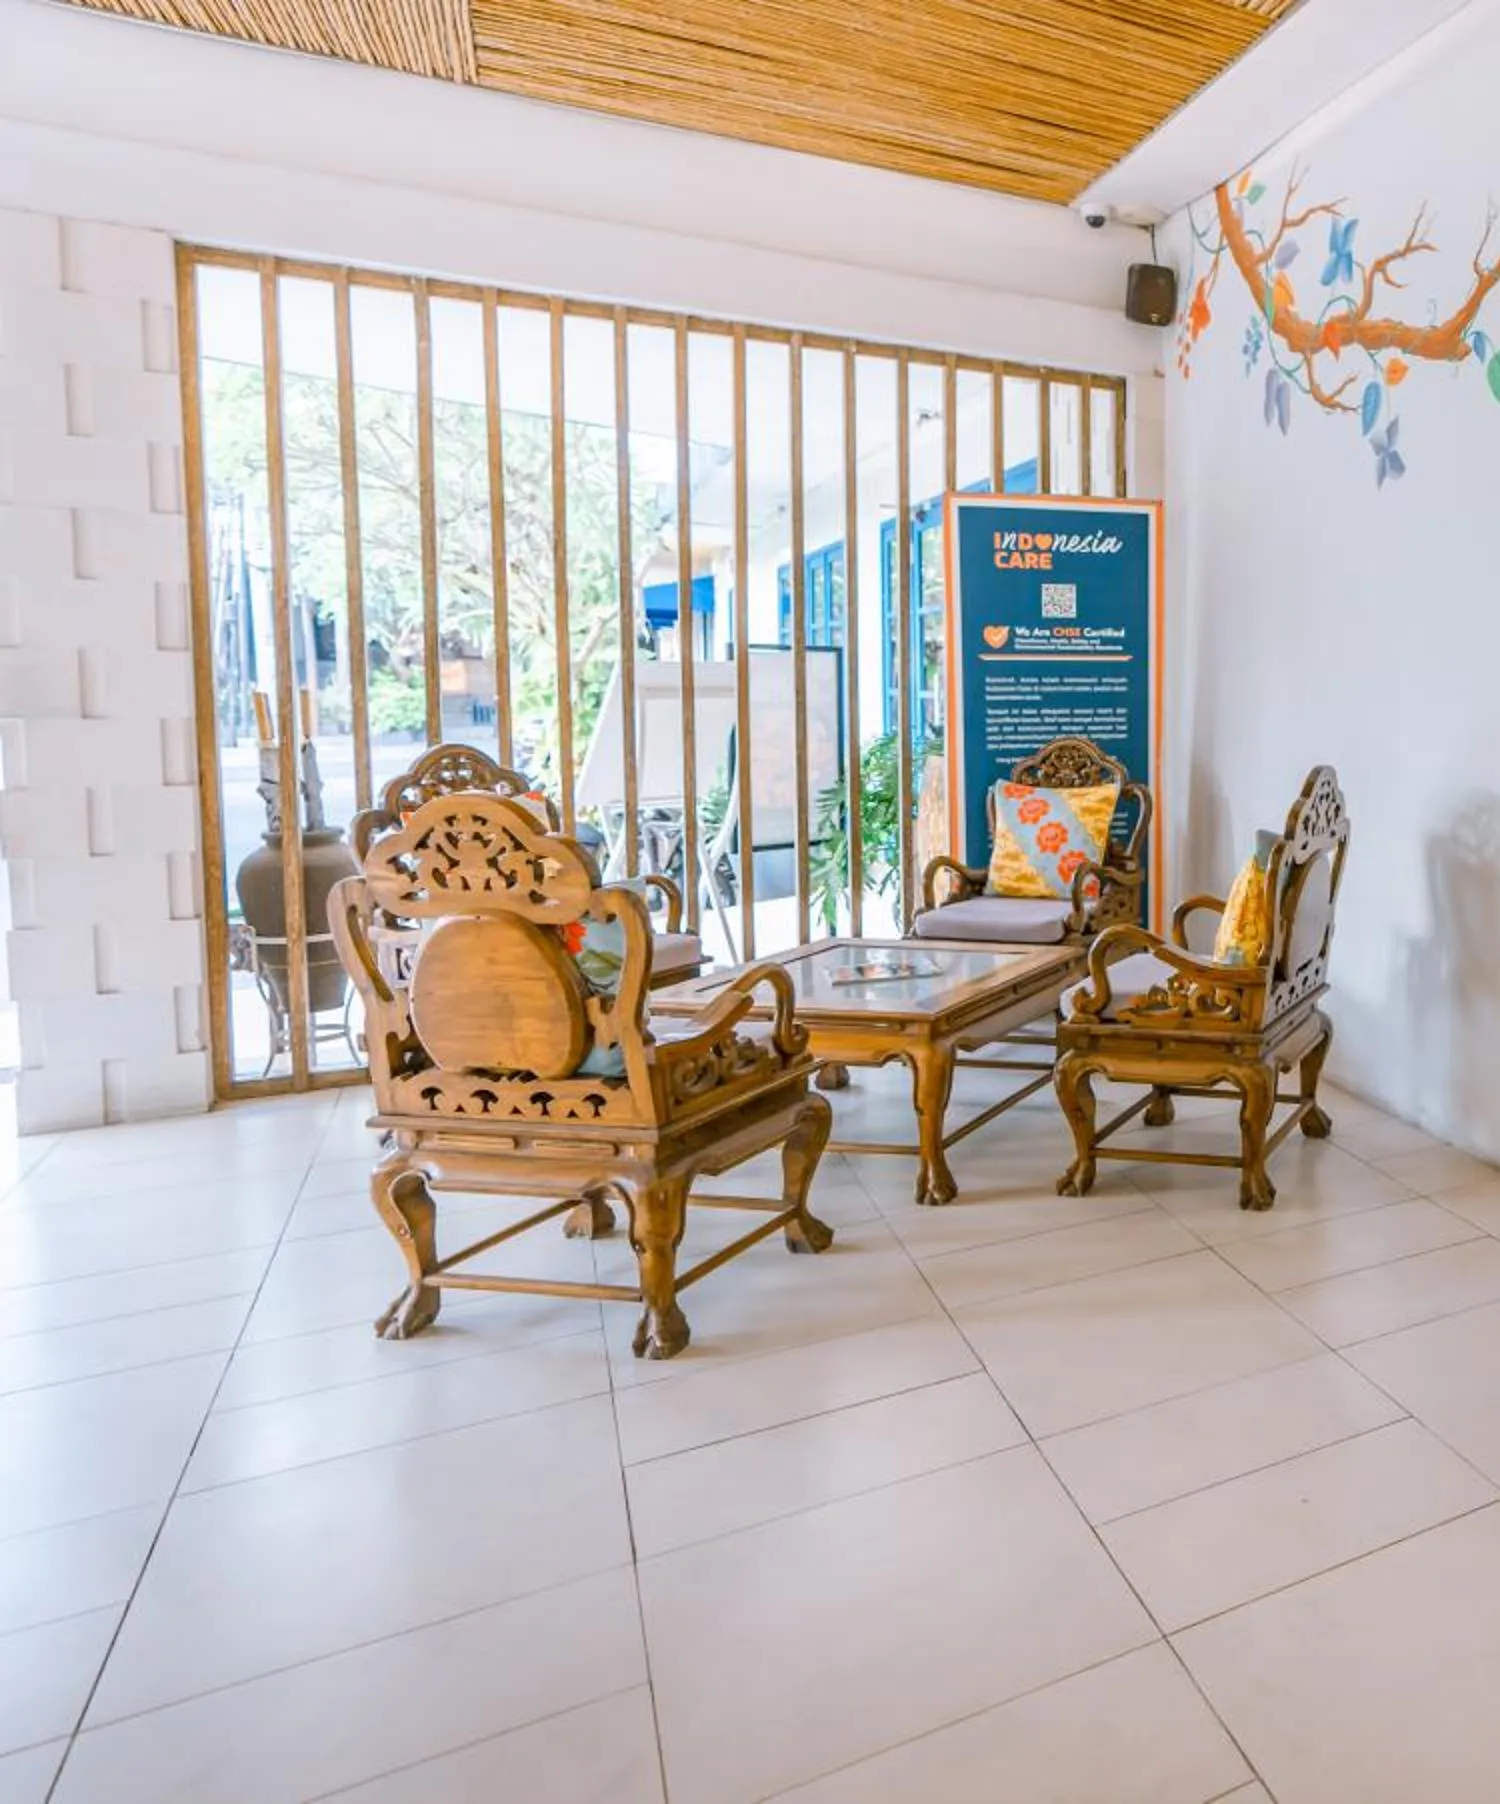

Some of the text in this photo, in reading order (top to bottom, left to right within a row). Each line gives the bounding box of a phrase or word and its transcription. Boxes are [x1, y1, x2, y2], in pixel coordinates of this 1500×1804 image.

[994, 552, 1053, 569] CARE
[1015, 627, 1030, 637] We
[1032, 627, 1050, 637] Are
[1083, 627, 1125, 637] Certified
